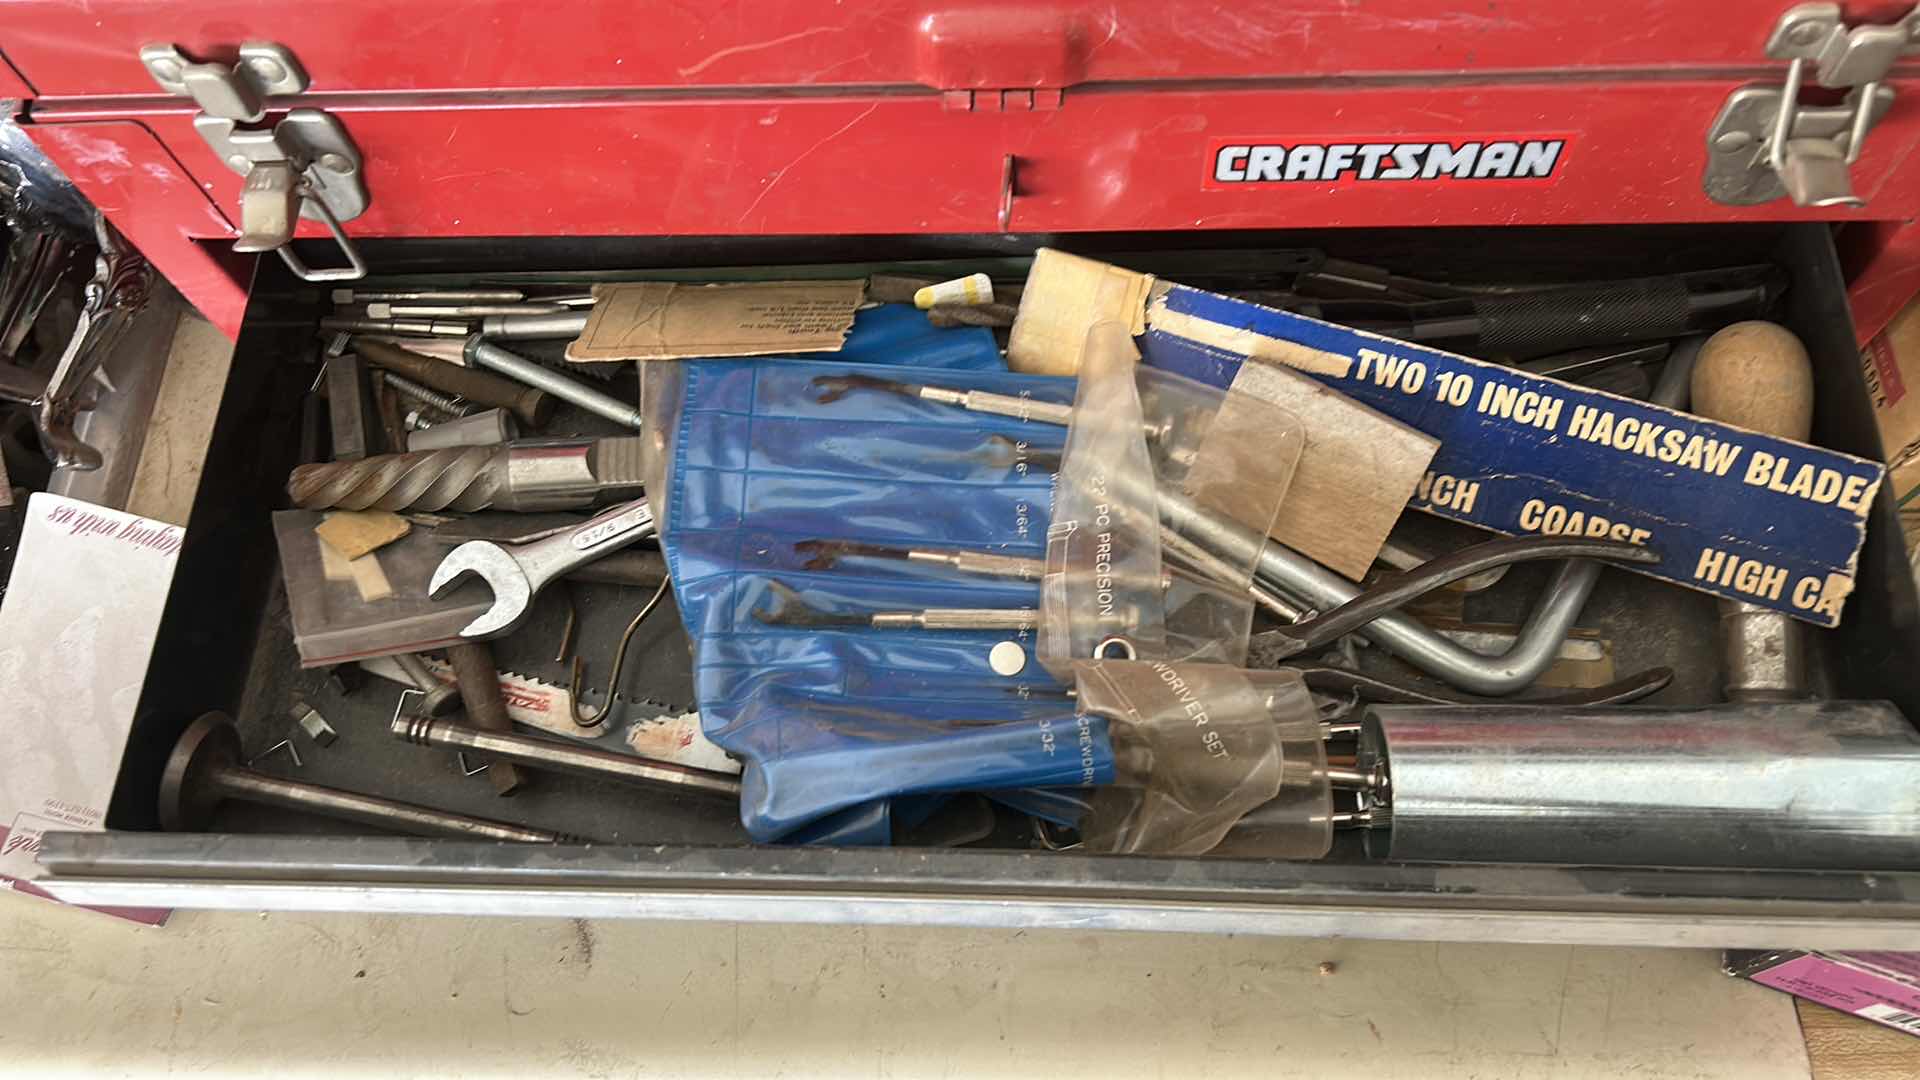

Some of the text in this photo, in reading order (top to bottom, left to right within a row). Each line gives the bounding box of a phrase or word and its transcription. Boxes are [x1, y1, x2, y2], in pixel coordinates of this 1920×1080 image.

[1214, 140, 1565, 182] CRAFTSMAN
[1356, 347, 1427, 395] TWO
[1435, 370, 1474, 407] 10
[1477, 381, 1564, 431] INCH
[1567, 404, 1742, 477] HACKSAW
[1415, 471, 1480, 514] NCH
[47, 505, 77, 524] us
[1095, 503, 1111, 526] PC
[1095, 532, 1113, 617] PRECISION
[1694, 547, 1789, 601] HIGH
[1201, 729, 1230, 760] SET
